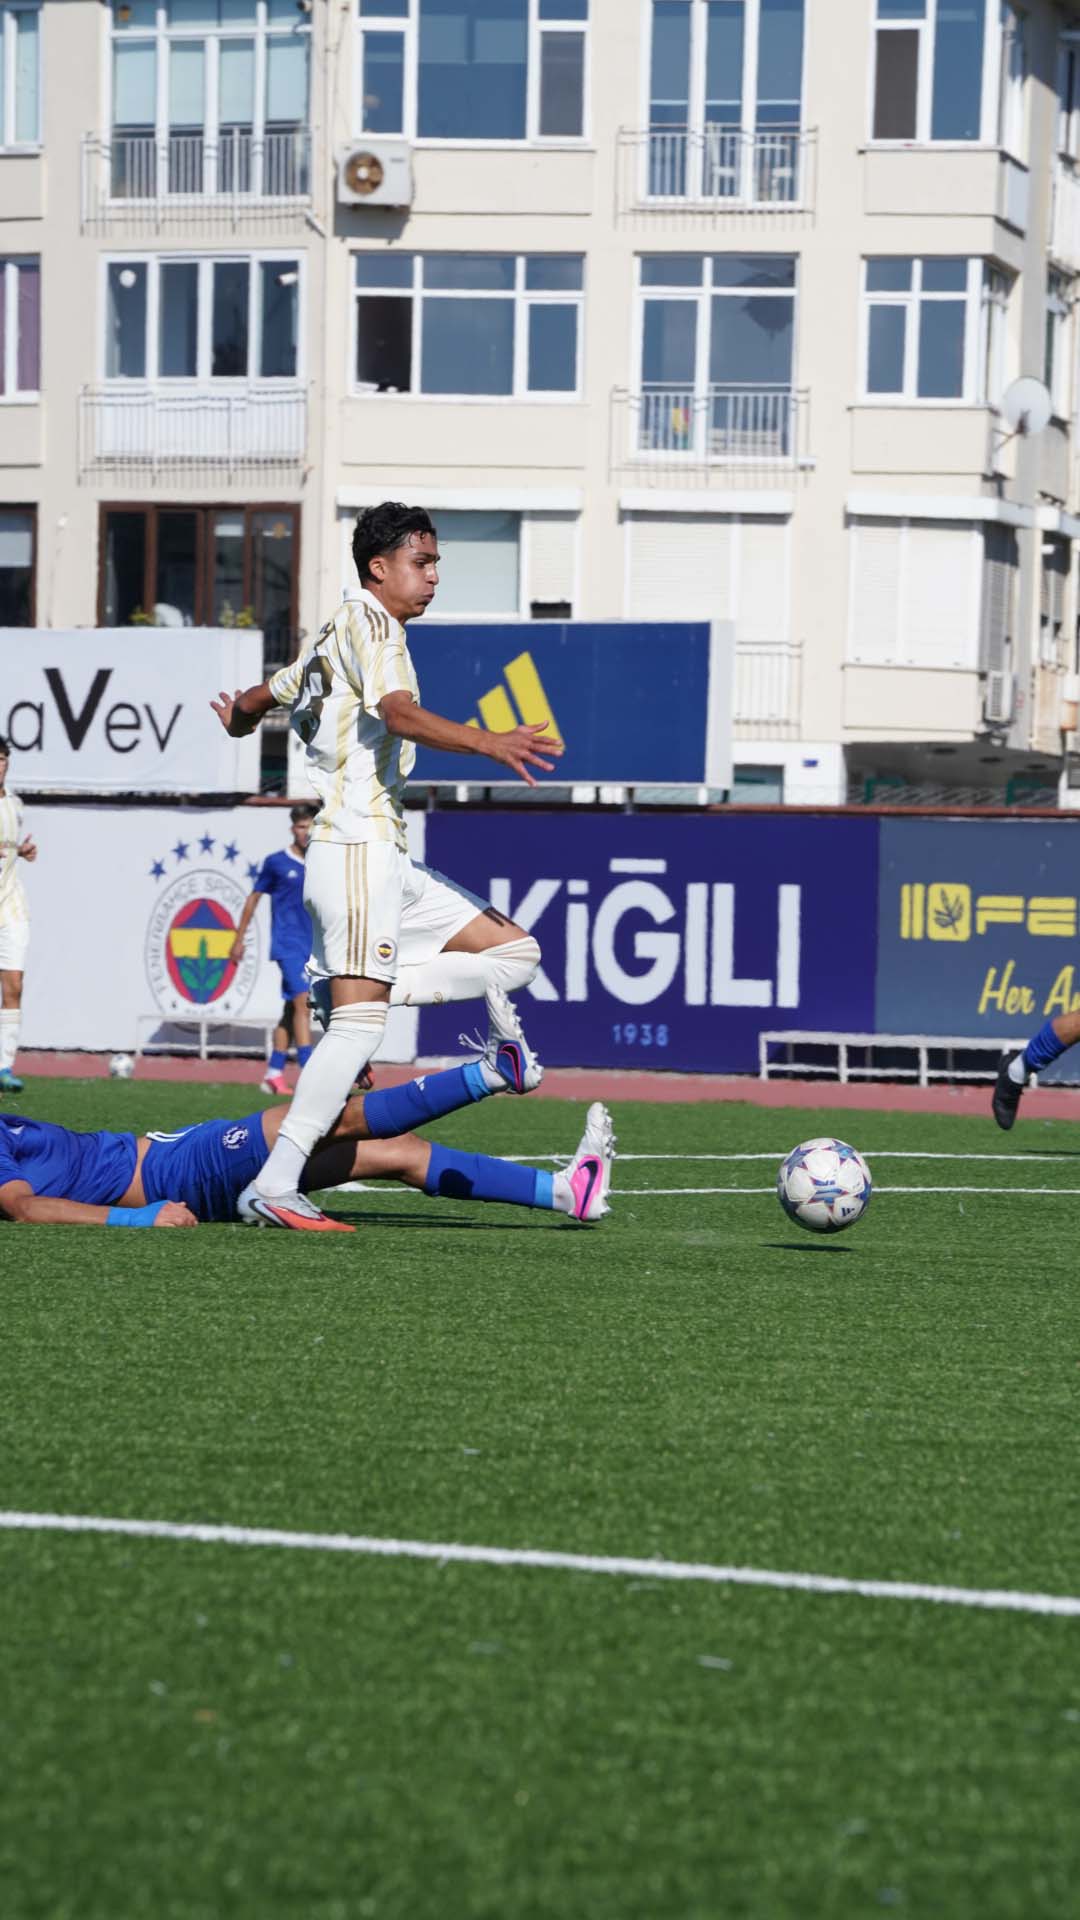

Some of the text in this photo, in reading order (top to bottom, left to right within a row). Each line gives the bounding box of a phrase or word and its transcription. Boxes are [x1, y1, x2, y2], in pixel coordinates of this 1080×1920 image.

[4, 667, 183, 753] aVev
[977, 959, 1036, 1015] Her
[612, 1023, 669, 1046] 1938
